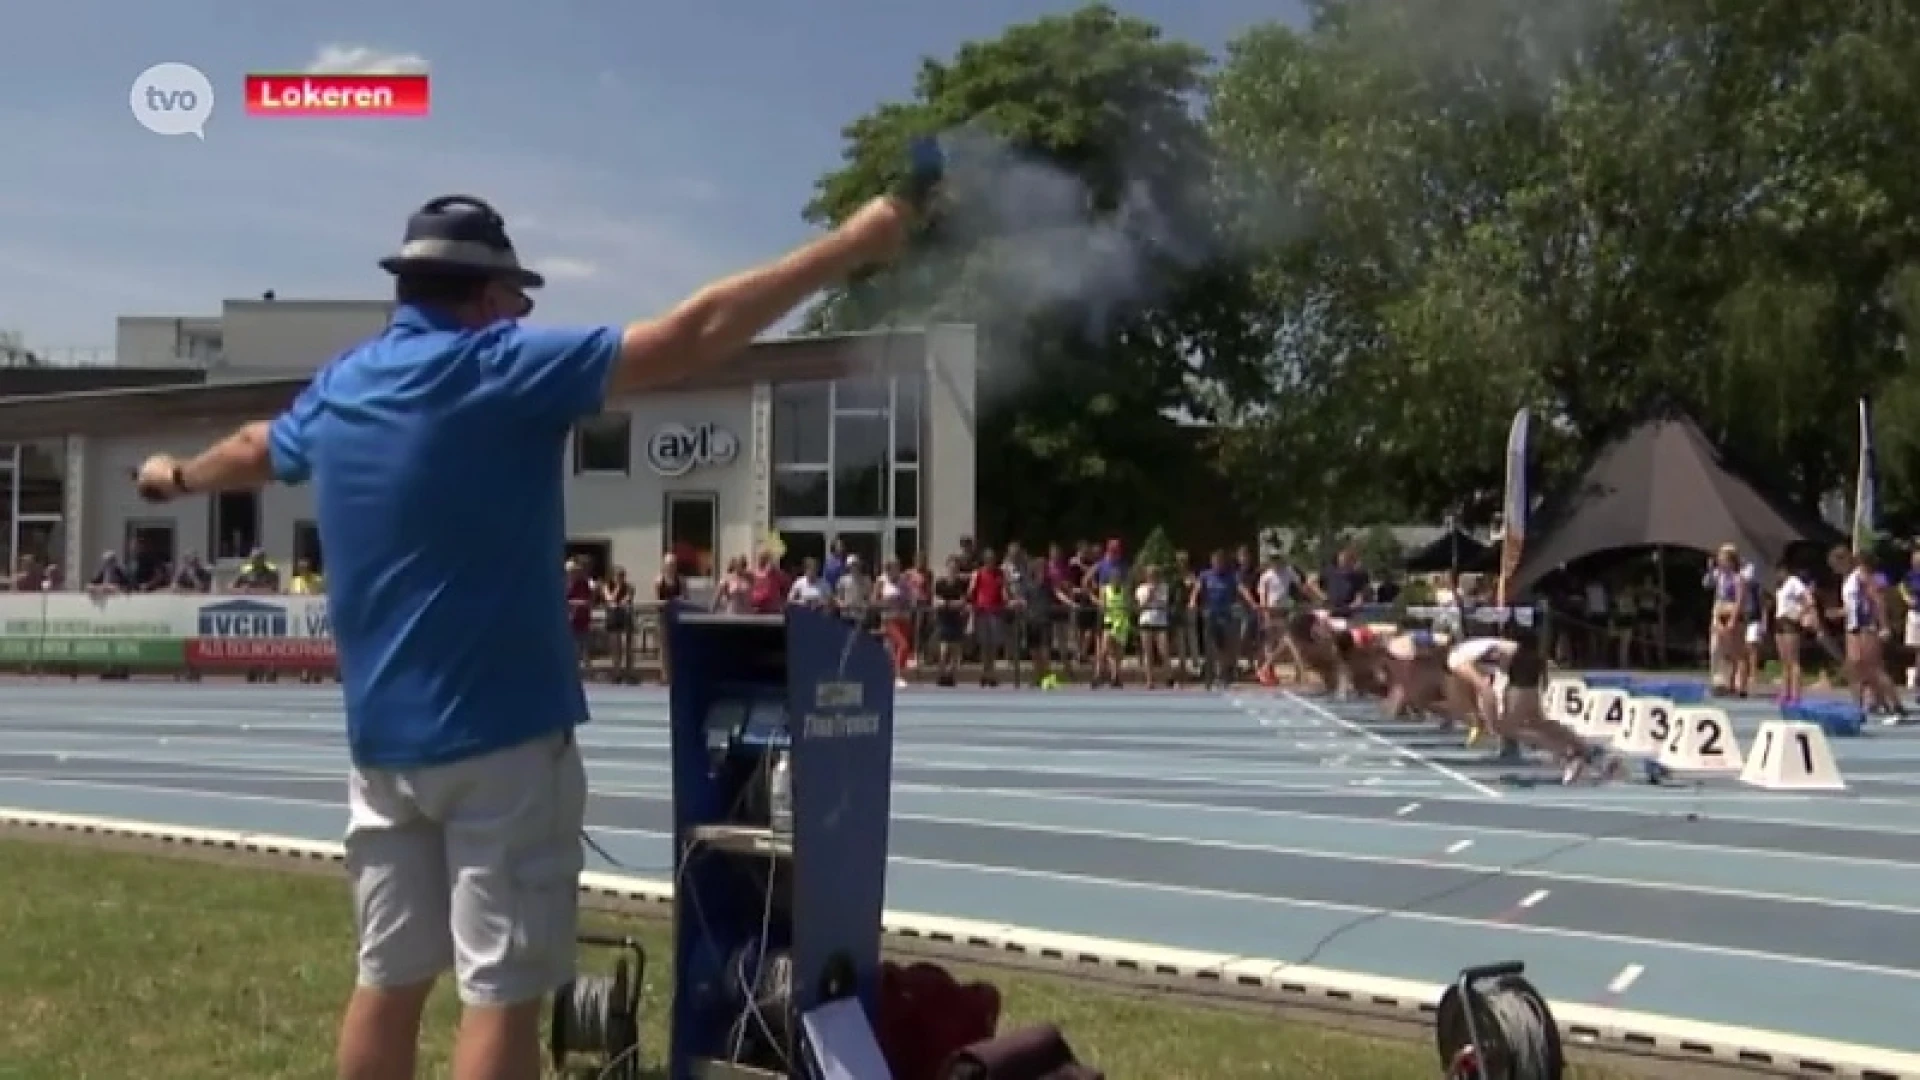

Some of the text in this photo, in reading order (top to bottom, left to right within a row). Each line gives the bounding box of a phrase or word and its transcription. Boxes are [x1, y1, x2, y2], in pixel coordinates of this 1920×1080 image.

[1565, 686, 1584, 716] 5
[1604, 695, 1624, 723] 4
[1650, 707, 1670, 741] 3
[1696, 719, 1724, 755] 2
[1795, 731, 1814, 775] 1
